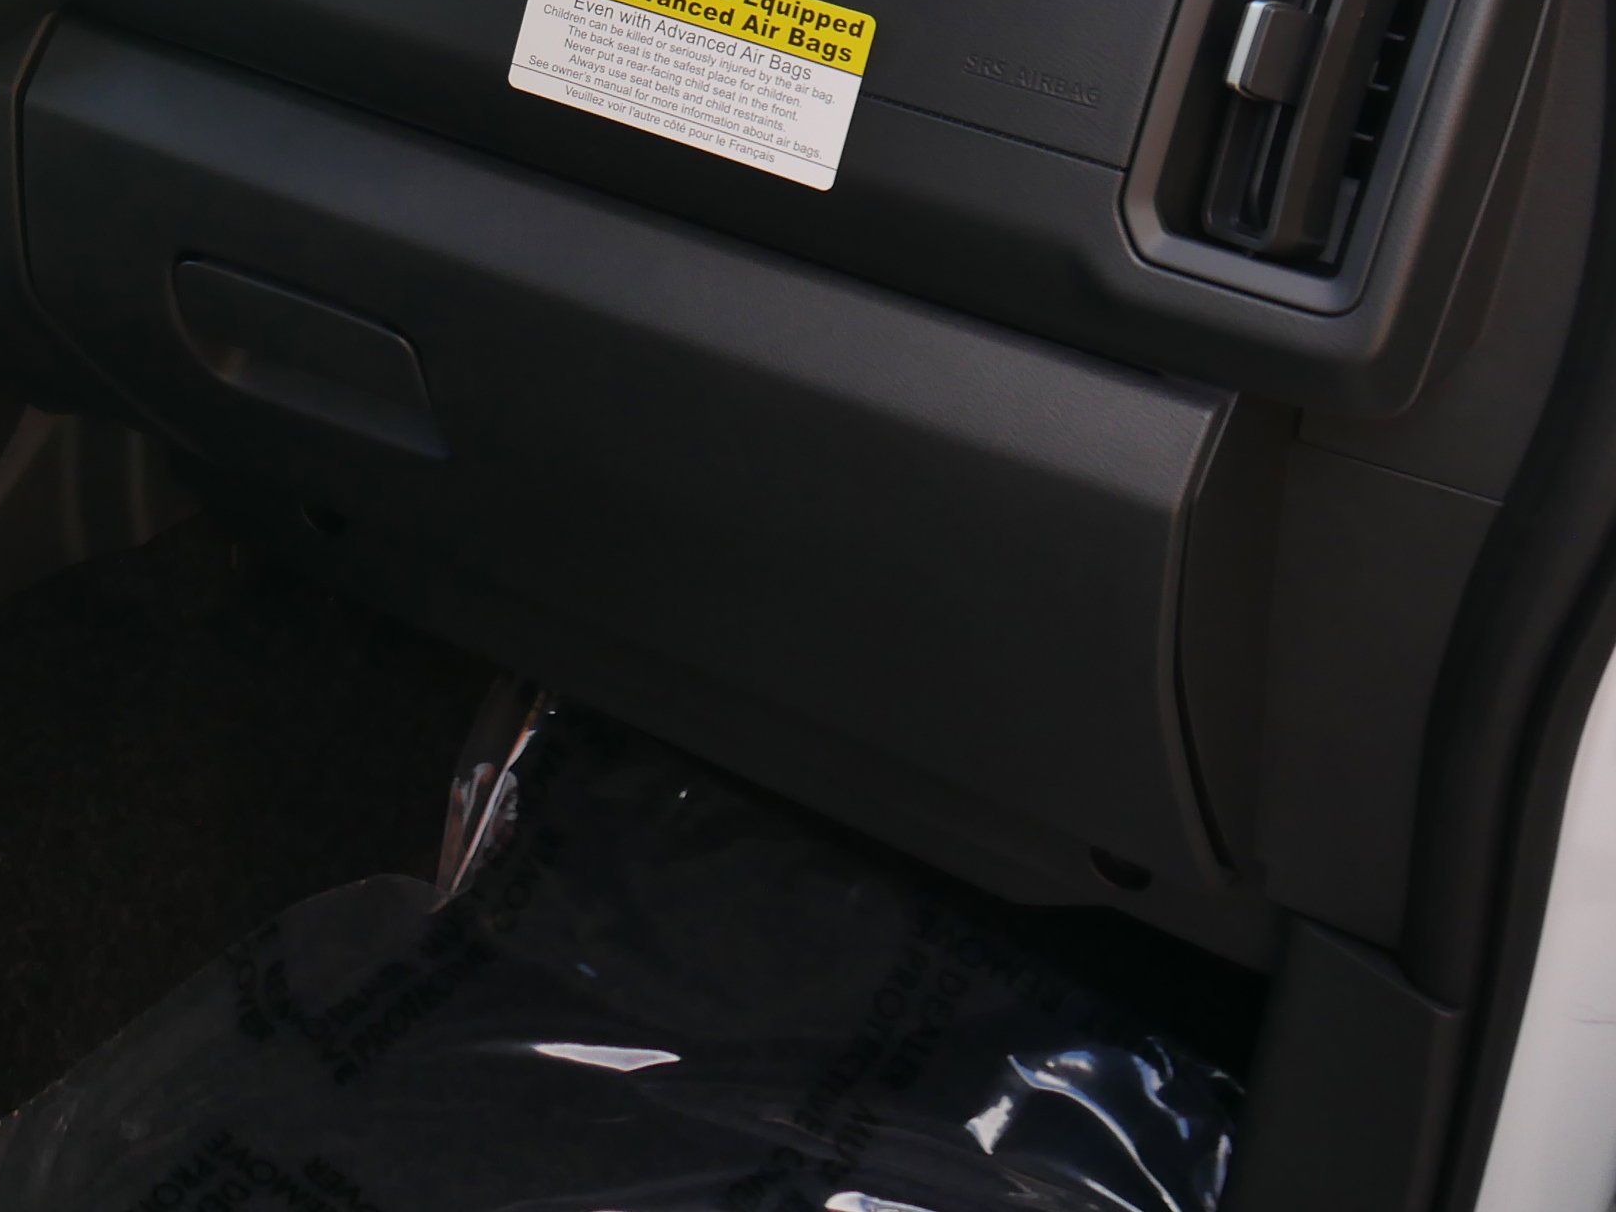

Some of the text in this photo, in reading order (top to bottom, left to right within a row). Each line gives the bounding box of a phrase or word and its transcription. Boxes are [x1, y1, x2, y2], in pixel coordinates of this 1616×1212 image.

[543, 3, 587, 26] Children
[588, 19, 609, 33] can
[625, 28, 655, 46] killed
[668, 44, 718, 68] seriously
[718, 57, 757, 79] injured
[773, 74, 794, 90] the
[793, 81, 810, 95] air
[810, 86, 837, 105] bag.
[568, 24, 588, 40] The
[589, 31, 615, 49] back
[616, 42, 641, 57] seat
[653, 51, 671, 66] the
[672, 59, 706, 77] safest
[706, 70, 738, 87] place
[739, 78, 756, 92] for
[755, 83, 804, 108] children.
[619, 10, 652, 31] with
[653, 19, 738, 57] Advanced
[739, 45, 766, 65] Air
[768, 53, 812, 80] Bags
[740, 14, 781, 40] Air
[787, 26, 853, 63] Bags
[528, 54, 822, 160] See owner's manual for more information about air bags.
[563, 37, 597, 56] Never
[596, 50, 615, 63] put
[625, 59, 683, 87] rear-facing
[684, 77, 711, 93] child
[712, 86, 737, 102] seat
[750, 97, 769, 112] the
[770, 103, 798, 122] front.
[567, 53, 786, 133] Always use seat belts and child restraints.
[962, 53, 1102, 105] SRS AIRBAG
[565, 84, 606, 107] Veuillez
[607, 100, 628, 114] voir
[628, 105, 661, 125] l'autre
[663, 118, 687, 134] côté
[687, 127, 715, 142] pour
[728, 138, 775, 164] Français
